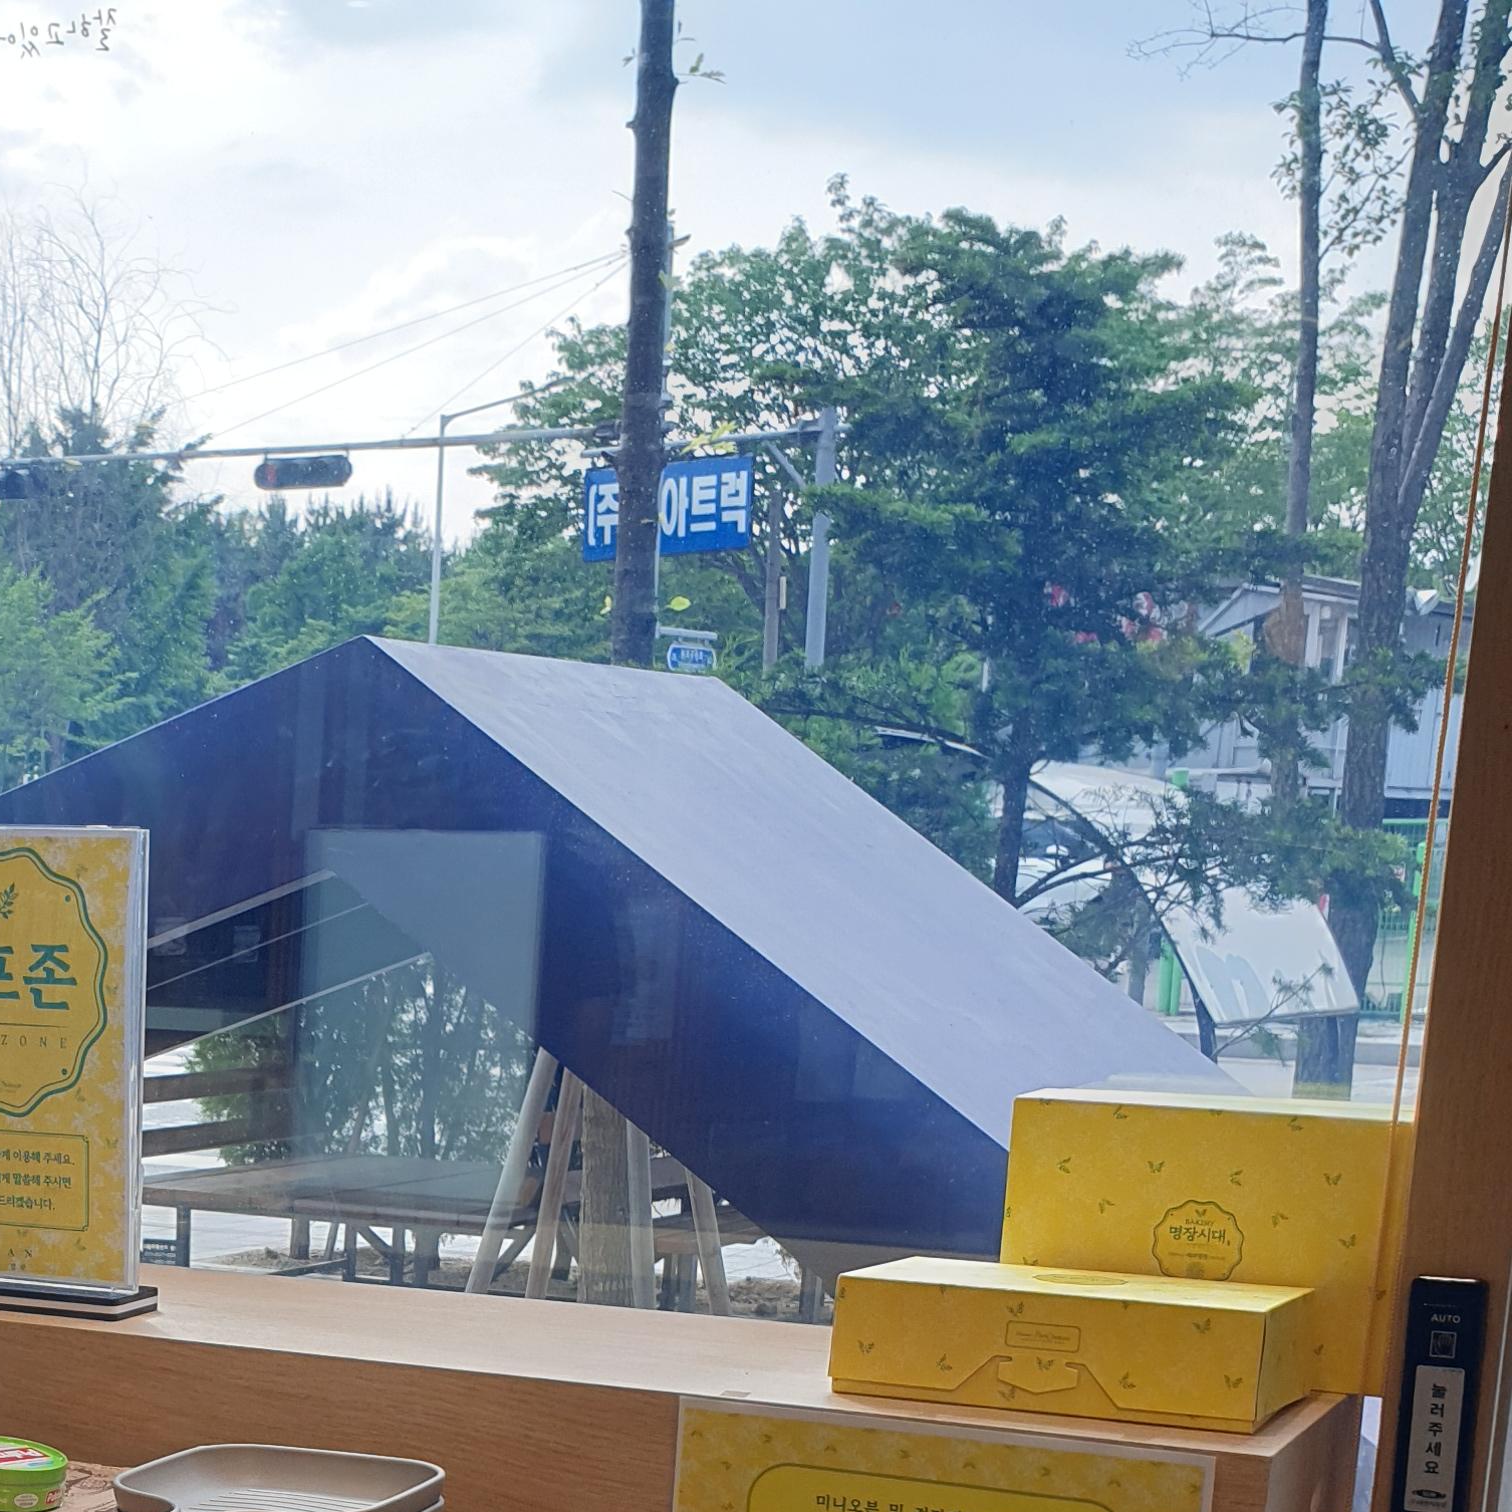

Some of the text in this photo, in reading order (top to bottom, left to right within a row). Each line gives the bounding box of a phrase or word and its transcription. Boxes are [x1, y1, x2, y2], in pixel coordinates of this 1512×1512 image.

[13, 1149, 40, 1164] 이용해
[43, 1152, 75, 1166] 주세요.
[13, 1173, 41, 1187] 말씀해
[43, 1175, 72, 1190] 주시면
[1431, 1313, 1461, 1325] AUTO
[1424, 1383, 1448, 1474] 눌러주세요
